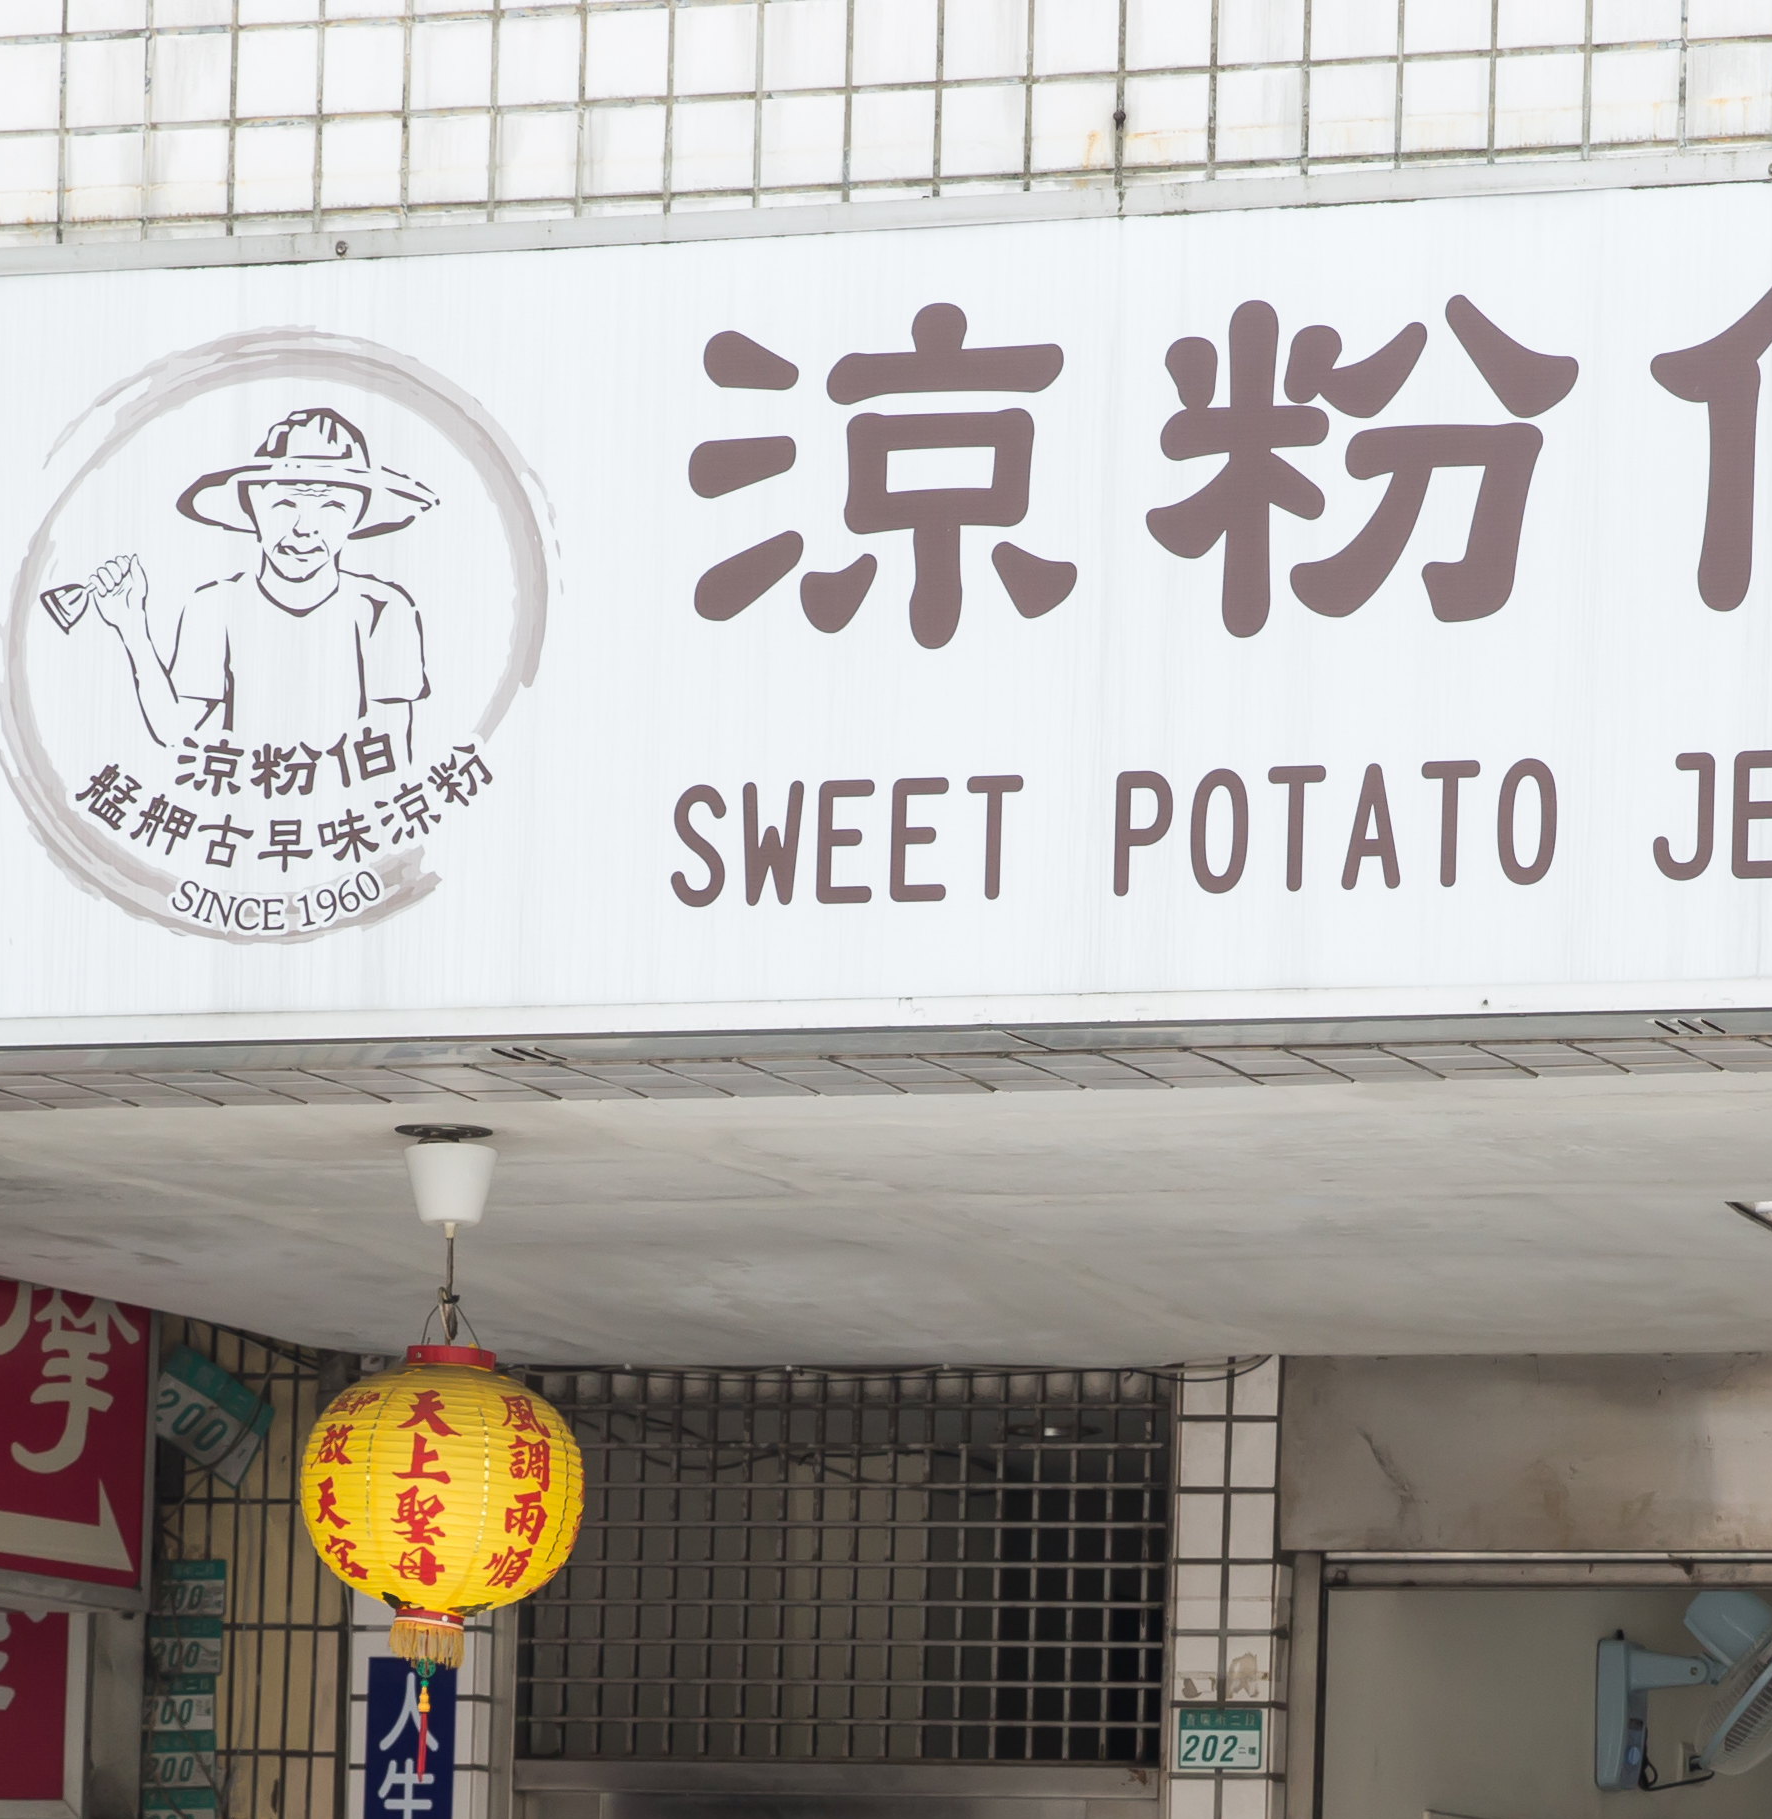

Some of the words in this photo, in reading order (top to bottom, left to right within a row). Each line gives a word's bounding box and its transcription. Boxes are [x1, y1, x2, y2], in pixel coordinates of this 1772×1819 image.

[75, 743, 493, 872] 艋舺古早味涼粉
[174, 727, 396, 799] 涼粉伯
[671, 775, 1025, 909] SWEET
[1114, 758, 1559, 898] POTATO
[173, 881, 286, 932] SINCE
[299, 872, 381, 928] 1960
[389, 1389, 462, 1586] 天上聖母
[483, 1394, 552, 1589] 風調雨順
[1181, 1734, 1238, 1763] 202
